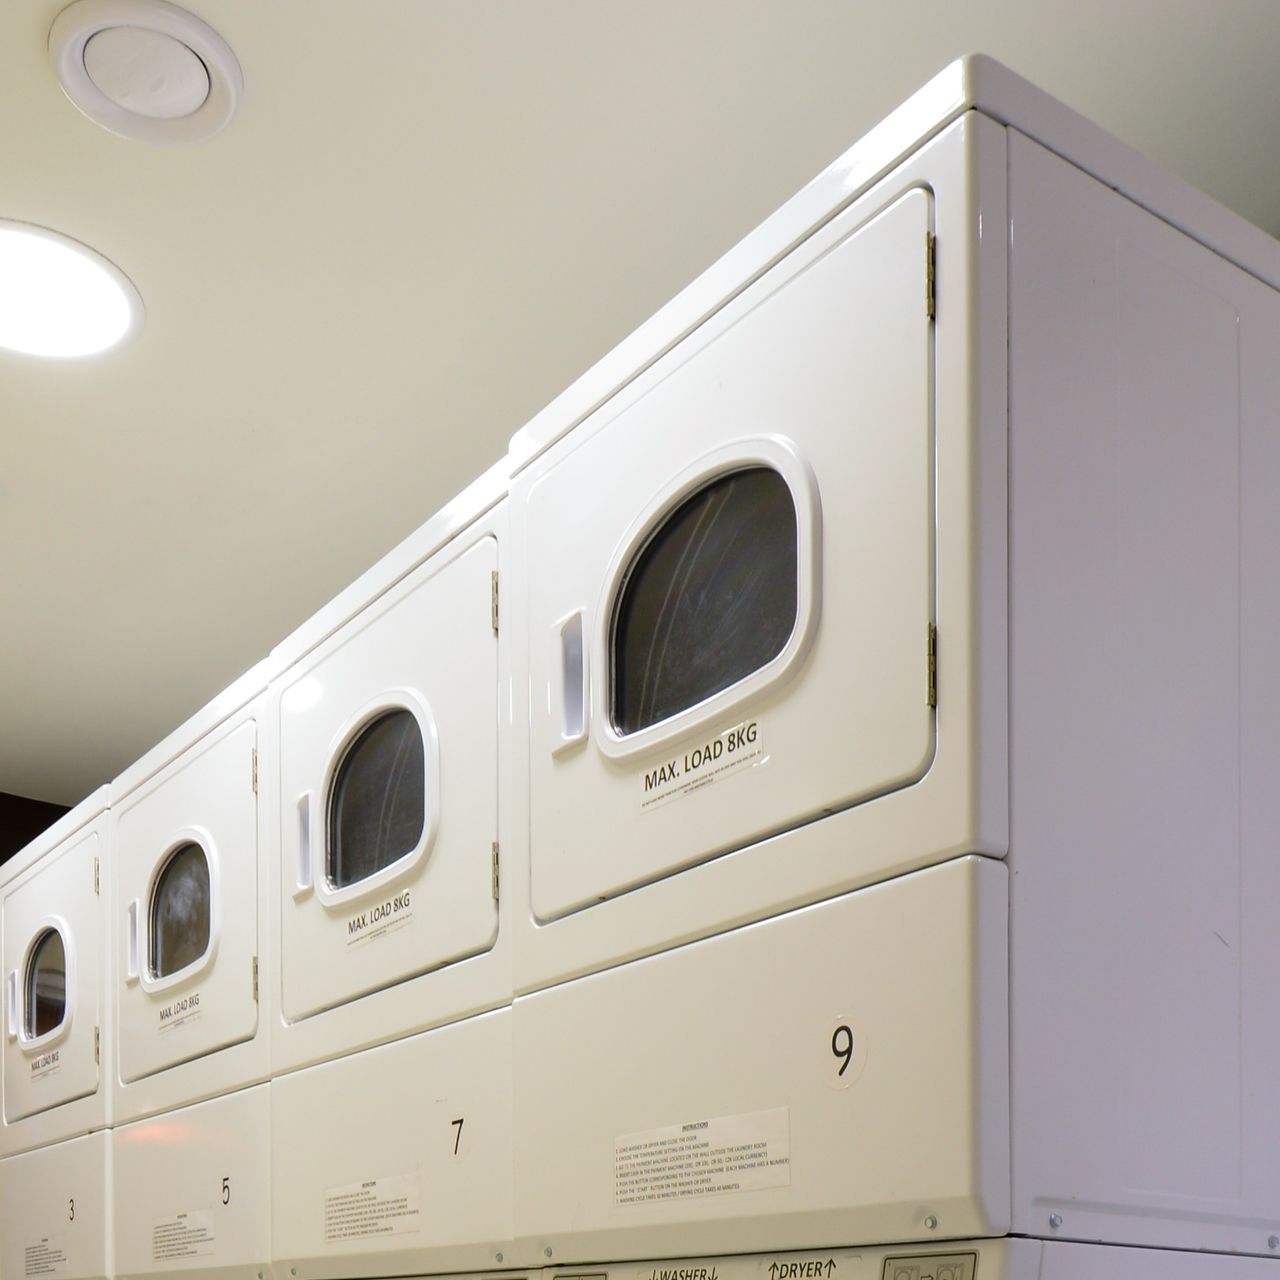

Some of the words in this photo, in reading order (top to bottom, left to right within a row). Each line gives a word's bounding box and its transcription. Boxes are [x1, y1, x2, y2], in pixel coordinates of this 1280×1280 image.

[644, 761, 679, 792] MAX.
[684, 740, 723, 773] LOAD
[727, 723, 757, 752] 8KG
[348, 913, 368, 935] MAX.
[370, 902, 391, 924] LOAD
[394, 892, 410, 912] 8KG
[831, 1025, 854, 1077] 9
[451, 1118, 465, 1156] 7
[69, 1199, 75, 1221] 3
[223, 1177, 230, 1205] 5
[780, 1262, 822, 1279] DRYER
